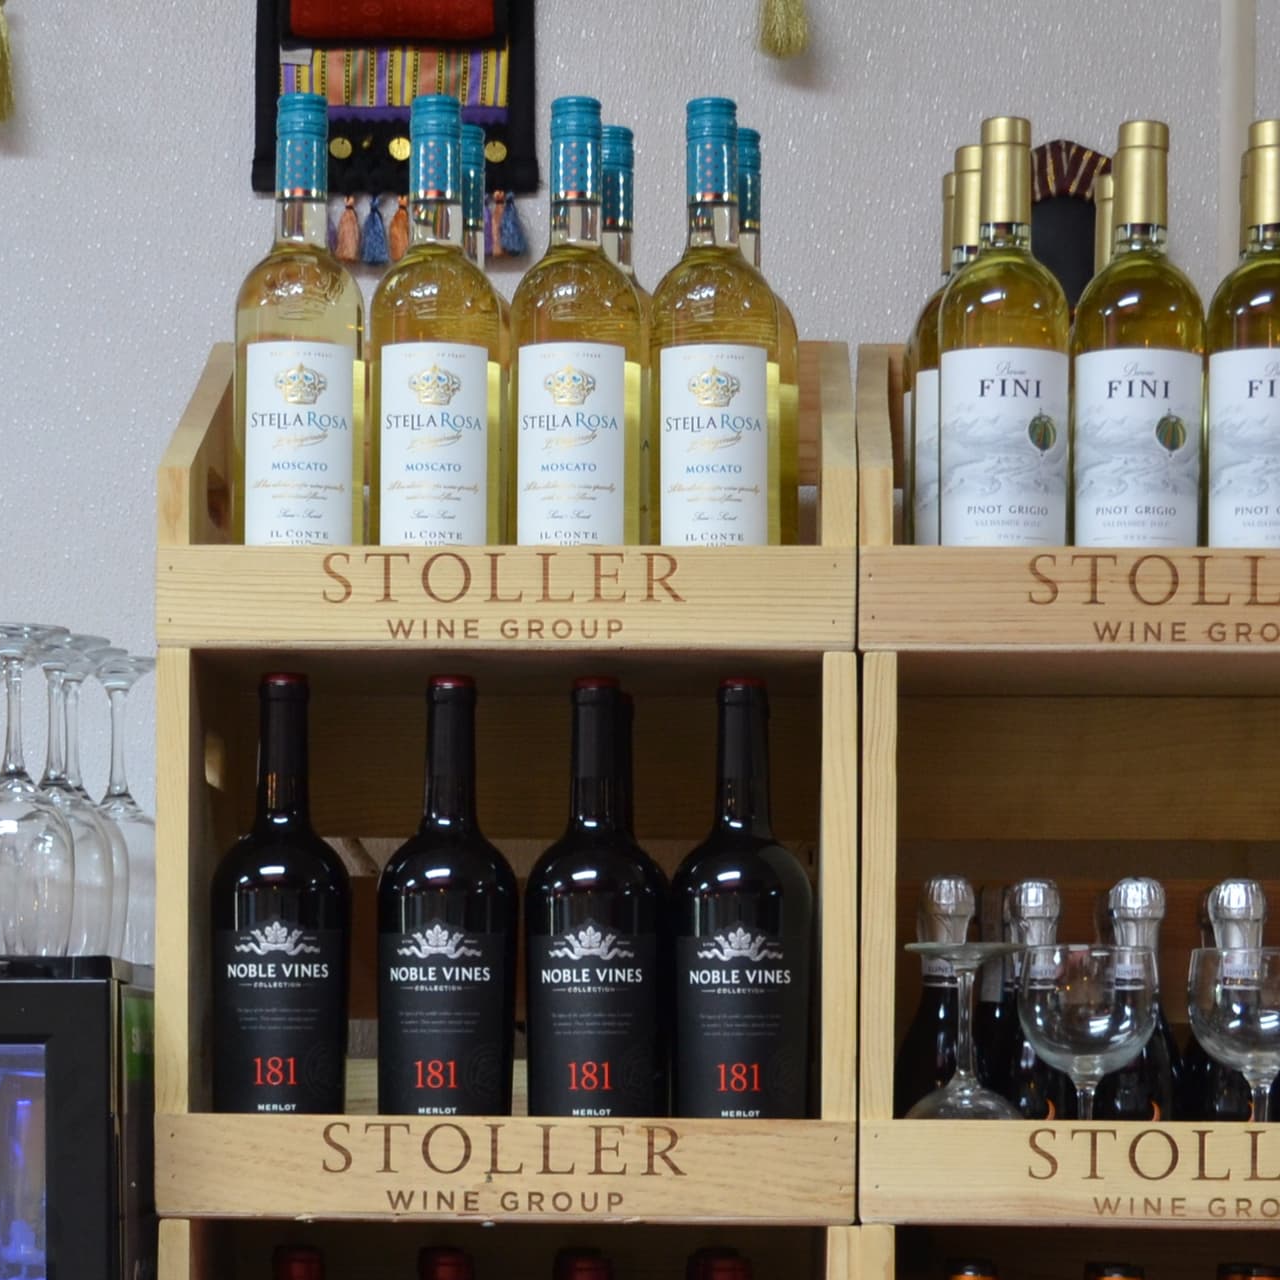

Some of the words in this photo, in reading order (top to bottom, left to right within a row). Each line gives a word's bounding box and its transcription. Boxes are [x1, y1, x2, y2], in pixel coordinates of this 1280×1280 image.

[978, 379, 1042, 398] FINI
[1107, 379, 1171, 399] FINI
[251, 412, 304, 430] STELLA
[308, 411, 348, 431] ROSA
[386, 413, 438, 431] STELLA
[440, 412, 482, 432] ROSA
[522, 414, 573, 431] STELLA
[575, 412, 618, 432] ROSA
[665, 415, 717, 433] STELLA
[720, 414, 762, 433] ROSA
[271, 462, 328, 472] MOSCATO
[405, 463, 462, 472] MOSCATO
[541, 463, 597, 472] MOSCATO
[686, 464, 742, 474] MOSCATO
[967, 505, 1002, 515] PINOT
[1008, 505, 1048, 517] GRIGIO
[322, 552, 686, 603] STOLLER
[386, 619, 480, 640] WINE
[500, 619, 624, 640] GROUP
[1094, 621, 1187, 642] WINE
[227, 964, 276, 978] NOBLE
[281, 964, 329, 978] VINES
[390, 967, 437, 982] NOBLE
[443, 967, 491, 982] VINES
[541, 968, 590, 983] NOBLE
[595, 968, 643, 983] VINES
[689, 969, 740, 985] NOBLE
[745, 969, 791, 985] VINES
[253, 1056, 297, 1086] 181
[415, 1060, 458, 1089] 181
[568, 1061, 612, 1091] 181
[716, 1063, 761, 1092] 181
[257, 1104, 297, 1112] MERLOT
[322, 1122, 687, 1176] STOLLER
[386, 1190, 480, 1211] WINE
[500, 1190, 624, 1212] GROUP
[1094, 1196, 1187, 1218] WINE
